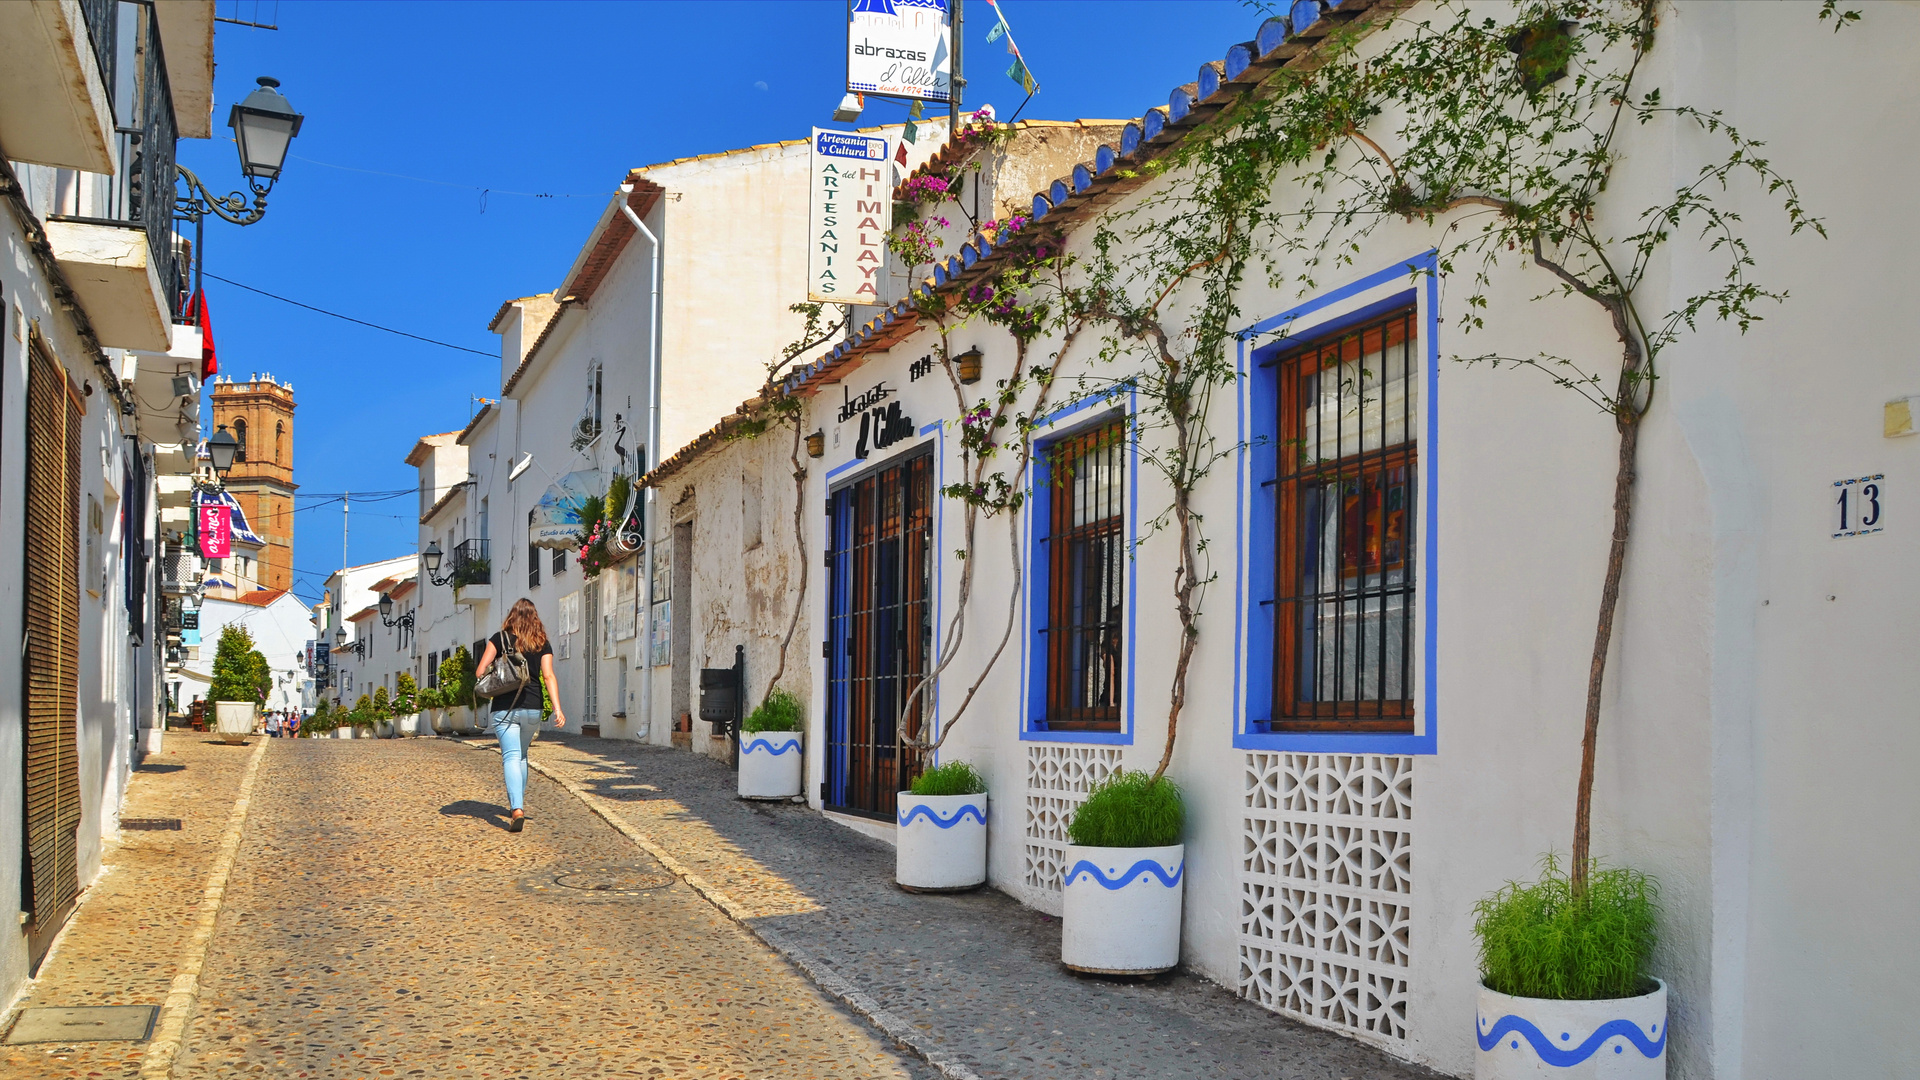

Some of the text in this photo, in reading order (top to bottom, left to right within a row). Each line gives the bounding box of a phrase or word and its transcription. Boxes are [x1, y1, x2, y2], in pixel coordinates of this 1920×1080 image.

[855, 37, 926, 61] abraxas
[879, 84, 922, 94] desde 1974
[820, 133, 866, 146] Artesania
[820, 144, 865, 157] y Cultura
[841, 170, 856, 179] del
[819, 163, 839, 294] ARTESANIAS
[855, 167, 881, 295] HIMALAYA
[1837, 483, 1880, 530] 13
